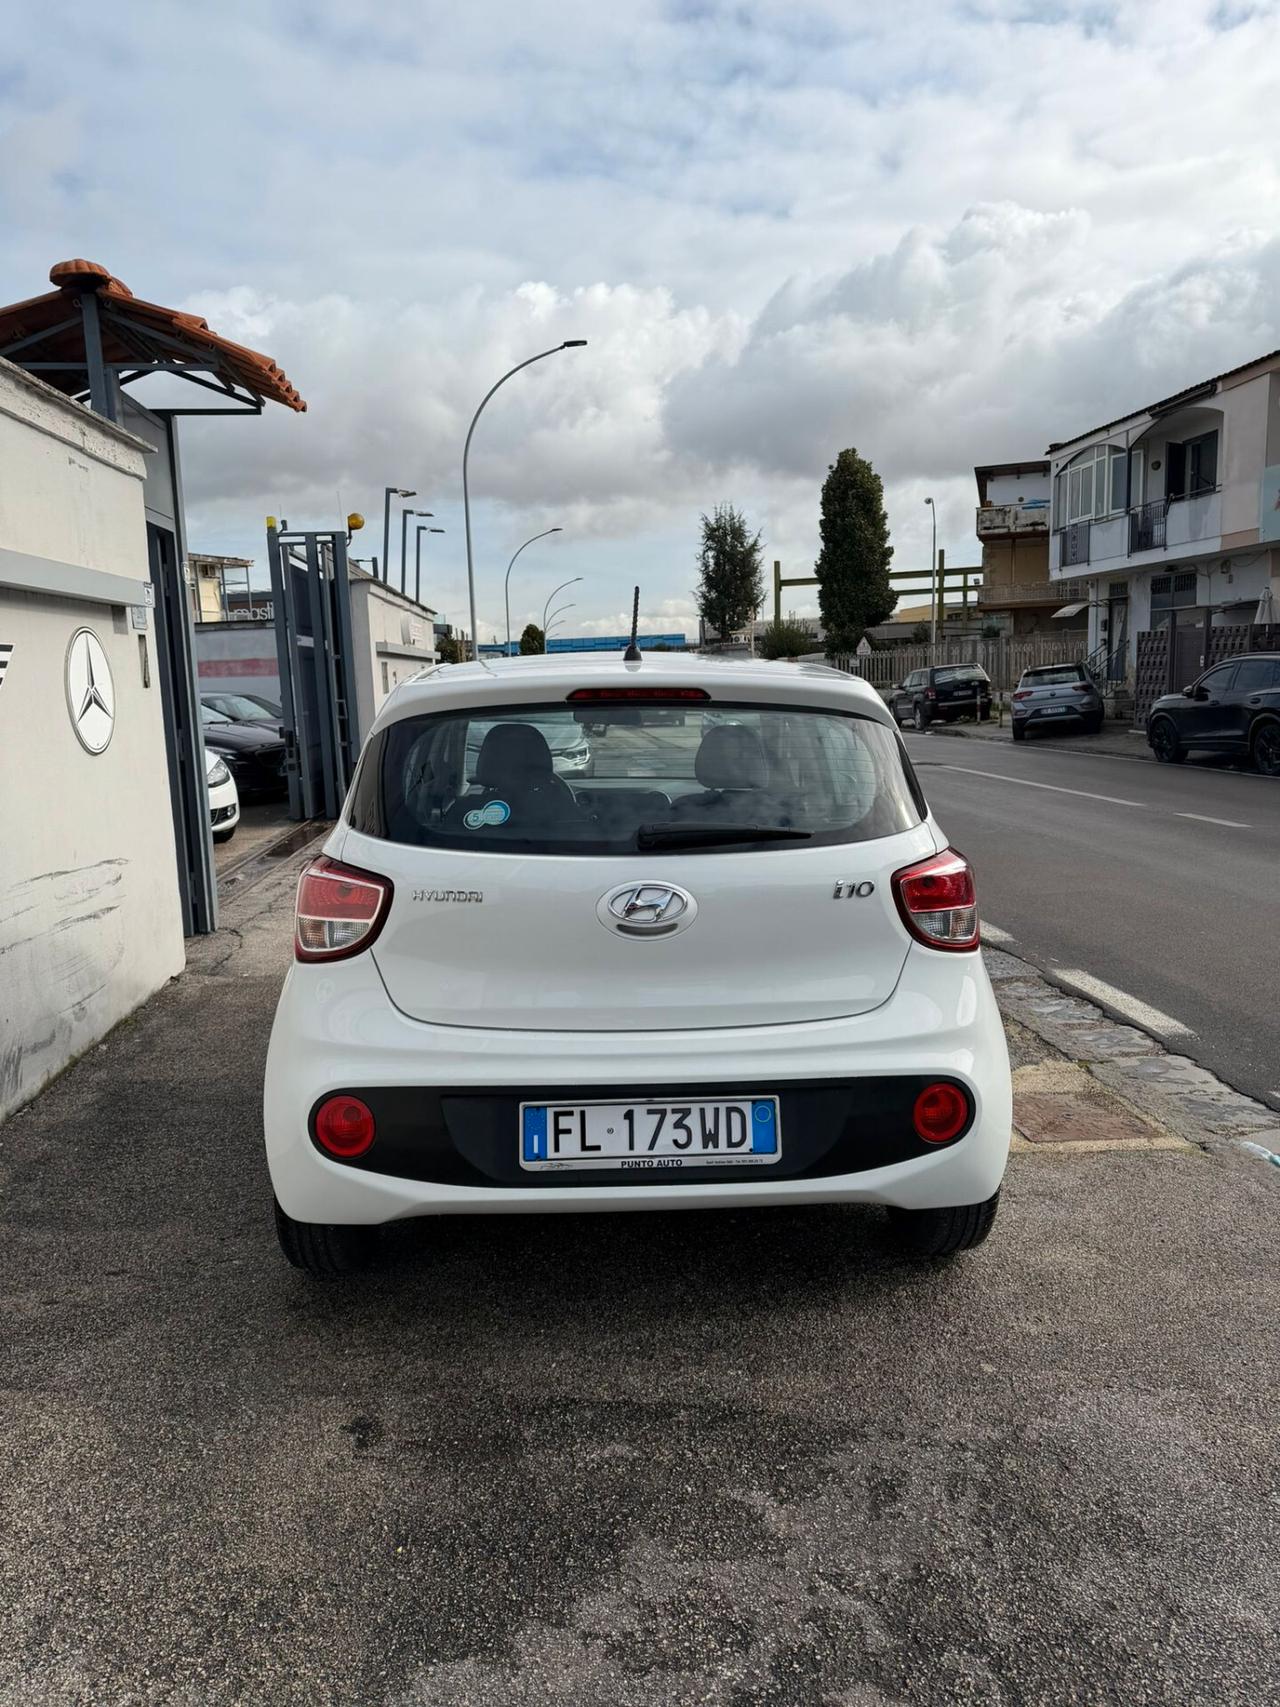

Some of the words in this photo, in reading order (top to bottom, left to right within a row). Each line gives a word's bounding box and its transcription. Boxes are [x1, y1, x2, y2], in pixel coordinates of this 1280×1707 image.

[413, 889, 483, 903] HYUNDAI
[833, 879, 875, 900] i10
[553, 1110, 601, 1153] FL
[623, 1106, 747, 1151] 173WD
[621, 1160, 654, 1169] PUNTO
[656, 1159, 683, 1168] AUTO
